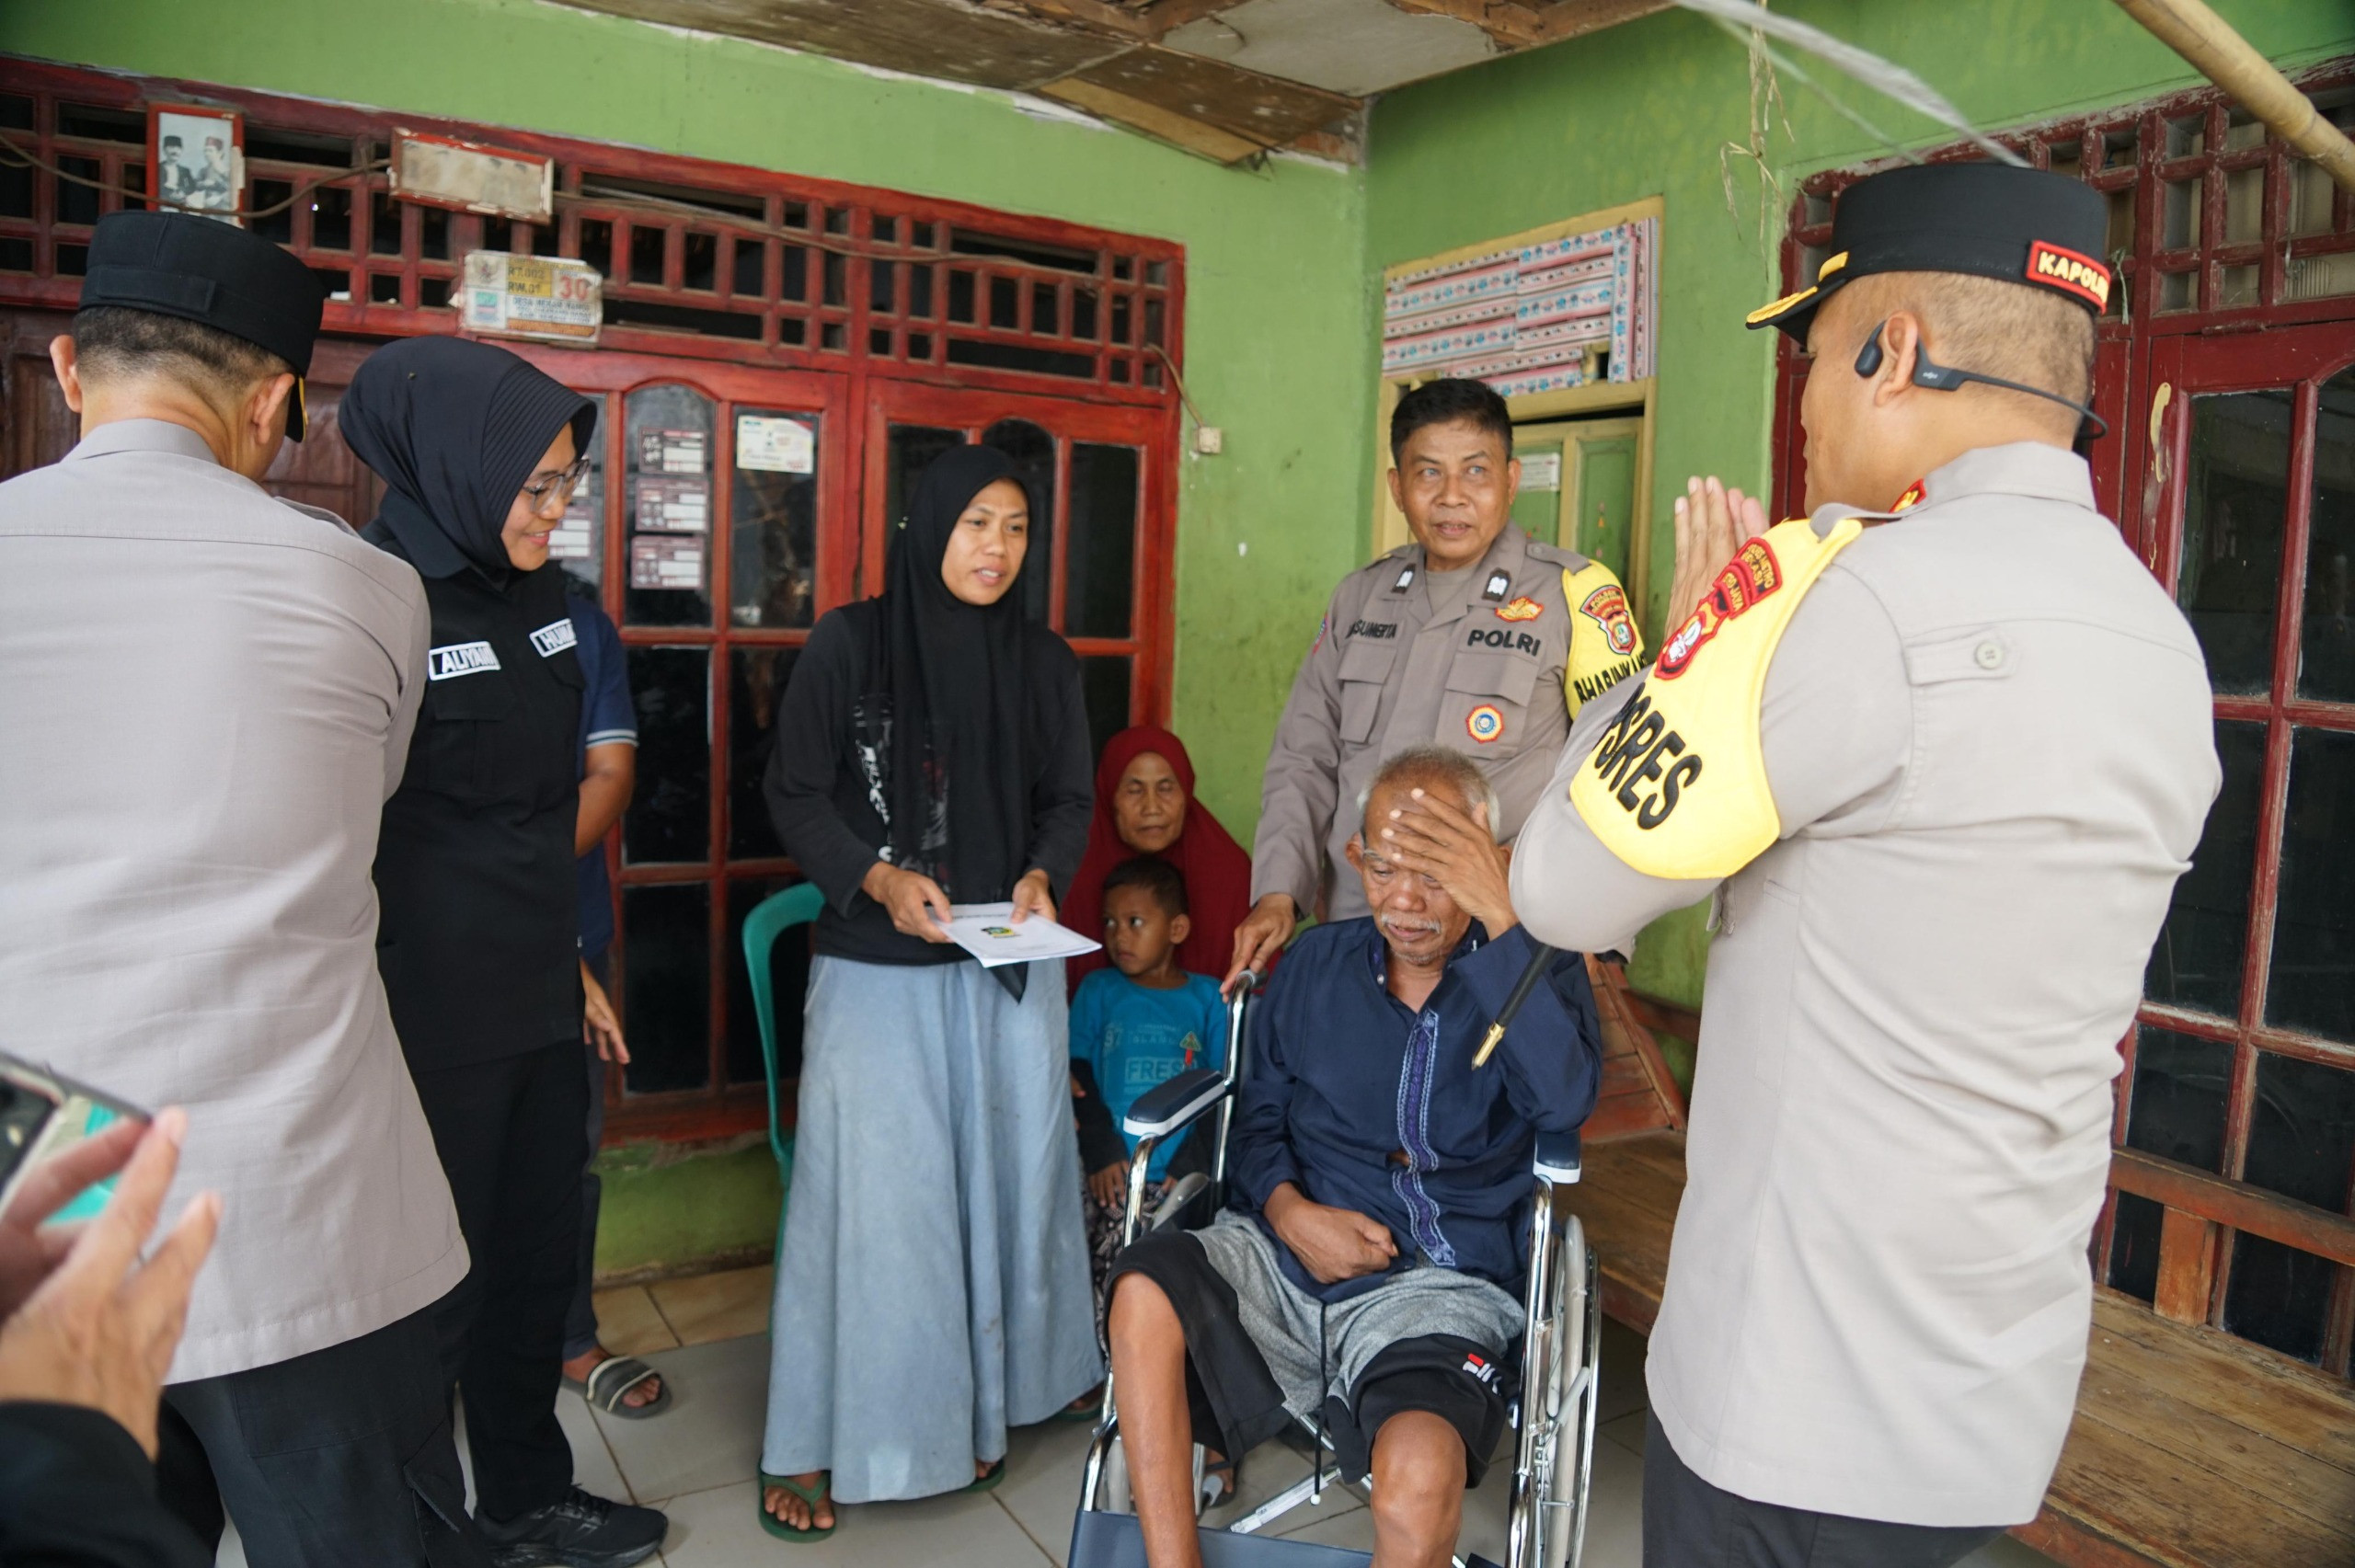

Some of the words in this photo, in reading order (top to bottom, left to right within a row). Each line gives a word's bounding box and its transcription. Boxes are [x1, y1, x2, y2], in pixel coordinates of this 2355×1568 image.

[559, 275, 590, 301] 30
[2038, 251, 2108, 303] KAPOL
[1466, 628, 1542, 658] POLRI
[1128, 1059, 1193, 1081] FRES
